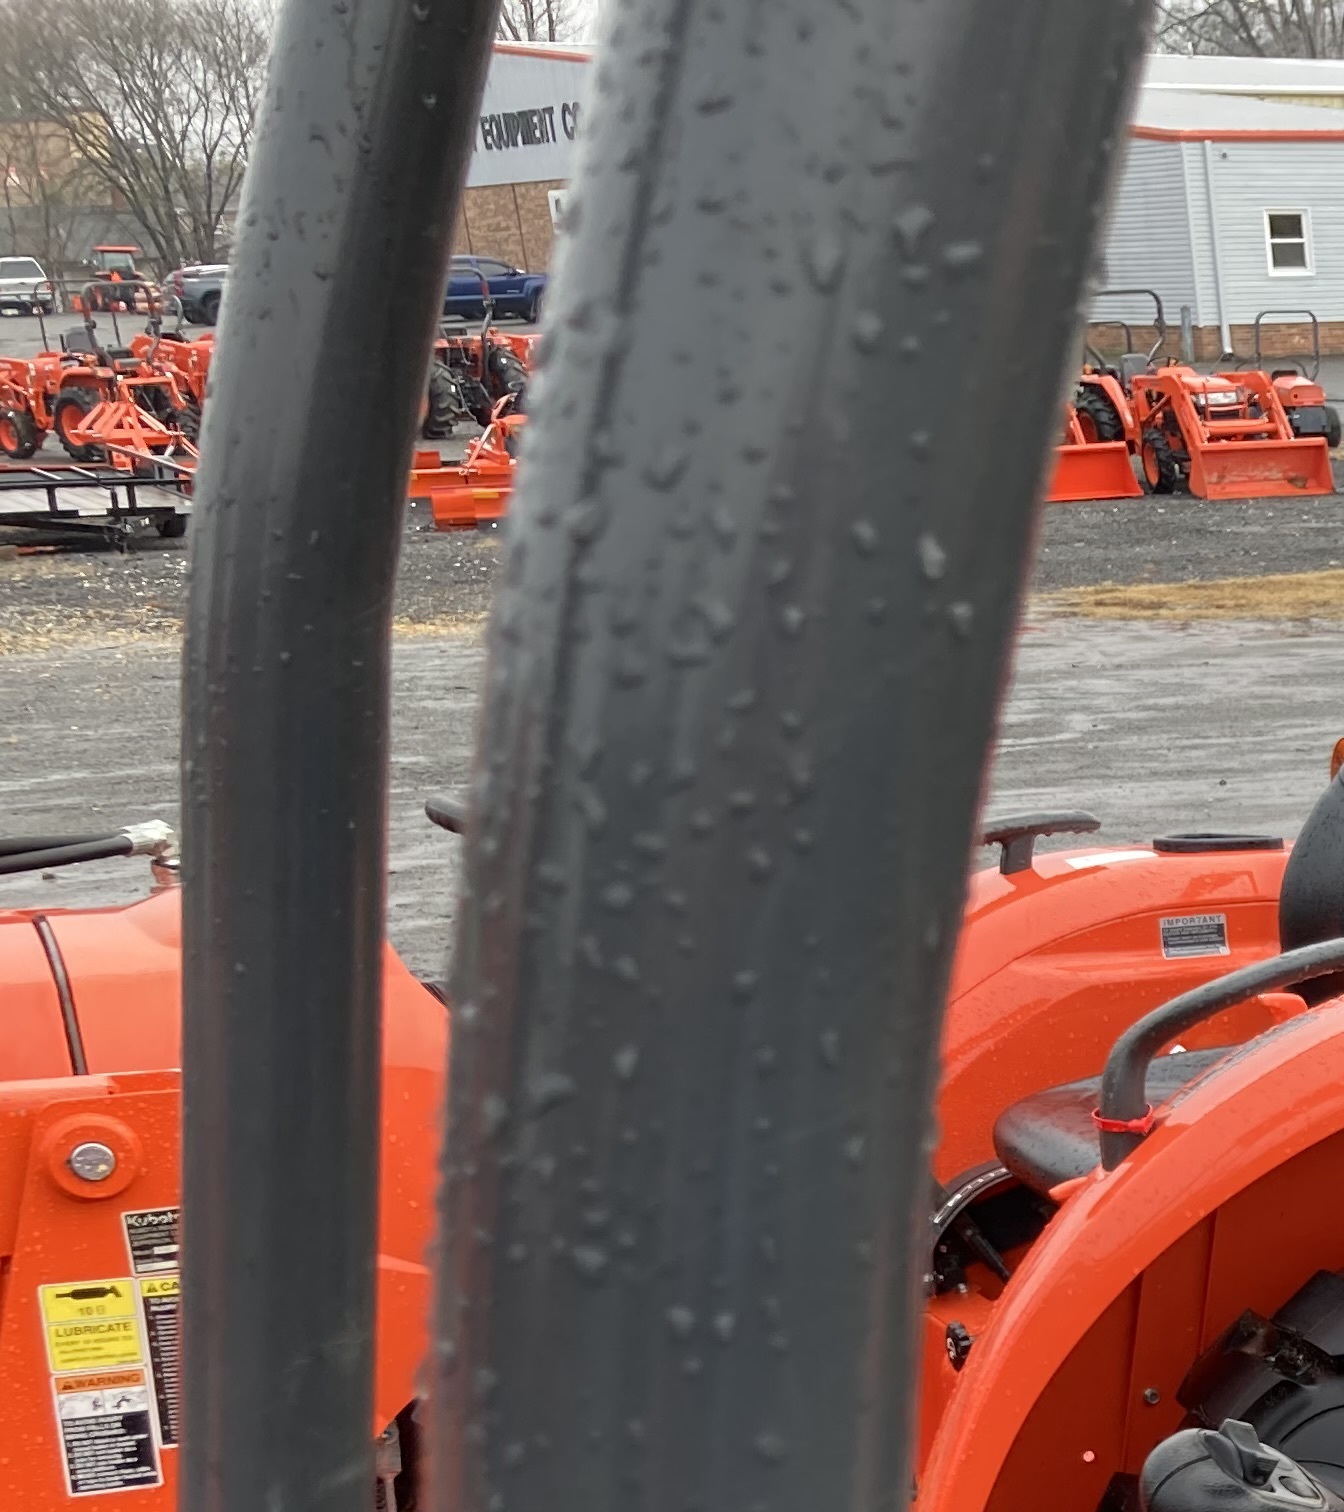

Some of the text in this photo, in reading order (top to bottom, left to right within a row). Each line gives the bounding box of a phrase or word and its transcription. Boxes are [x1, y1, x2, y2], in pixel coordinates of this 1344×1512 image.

[480, 106, 557, 151] EQUIPMENT
[1163, 915, 1222, 927] IMPORTANT
[55, 1321, 132, 1338] LUBRICATE
[75, 1373, 141, 1389] WARNING
